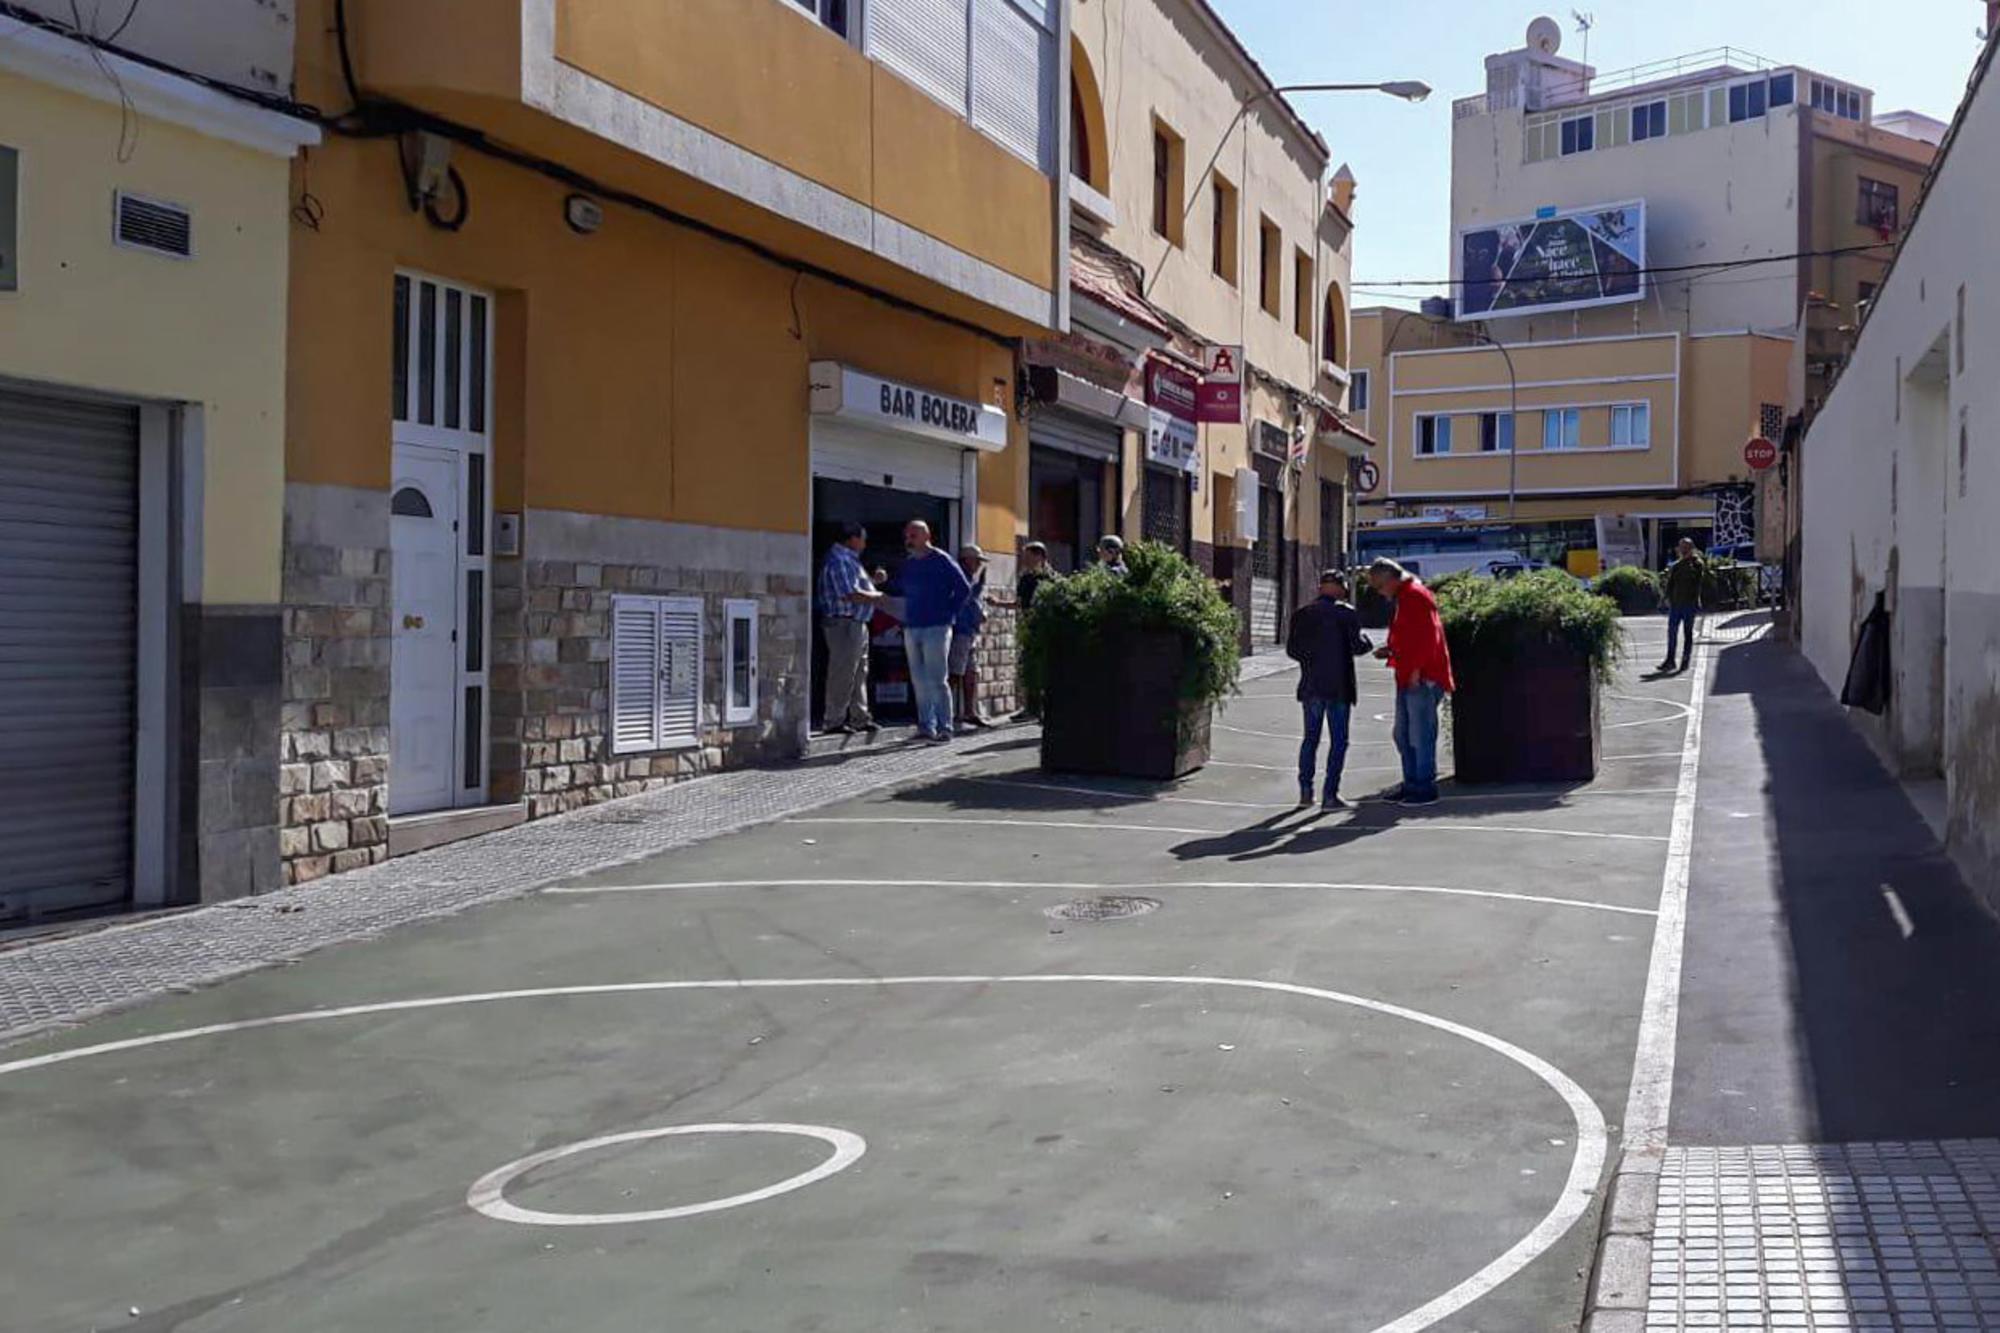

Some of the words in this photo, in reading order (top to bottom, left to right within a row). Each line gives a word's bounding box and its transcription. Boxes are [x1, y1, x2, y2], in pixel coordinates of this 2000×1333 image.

[880, 384, 915, 419] BAR
[921, 394, 978, 434] BOLERA
[1746, 448, 1774, 459] STOP
